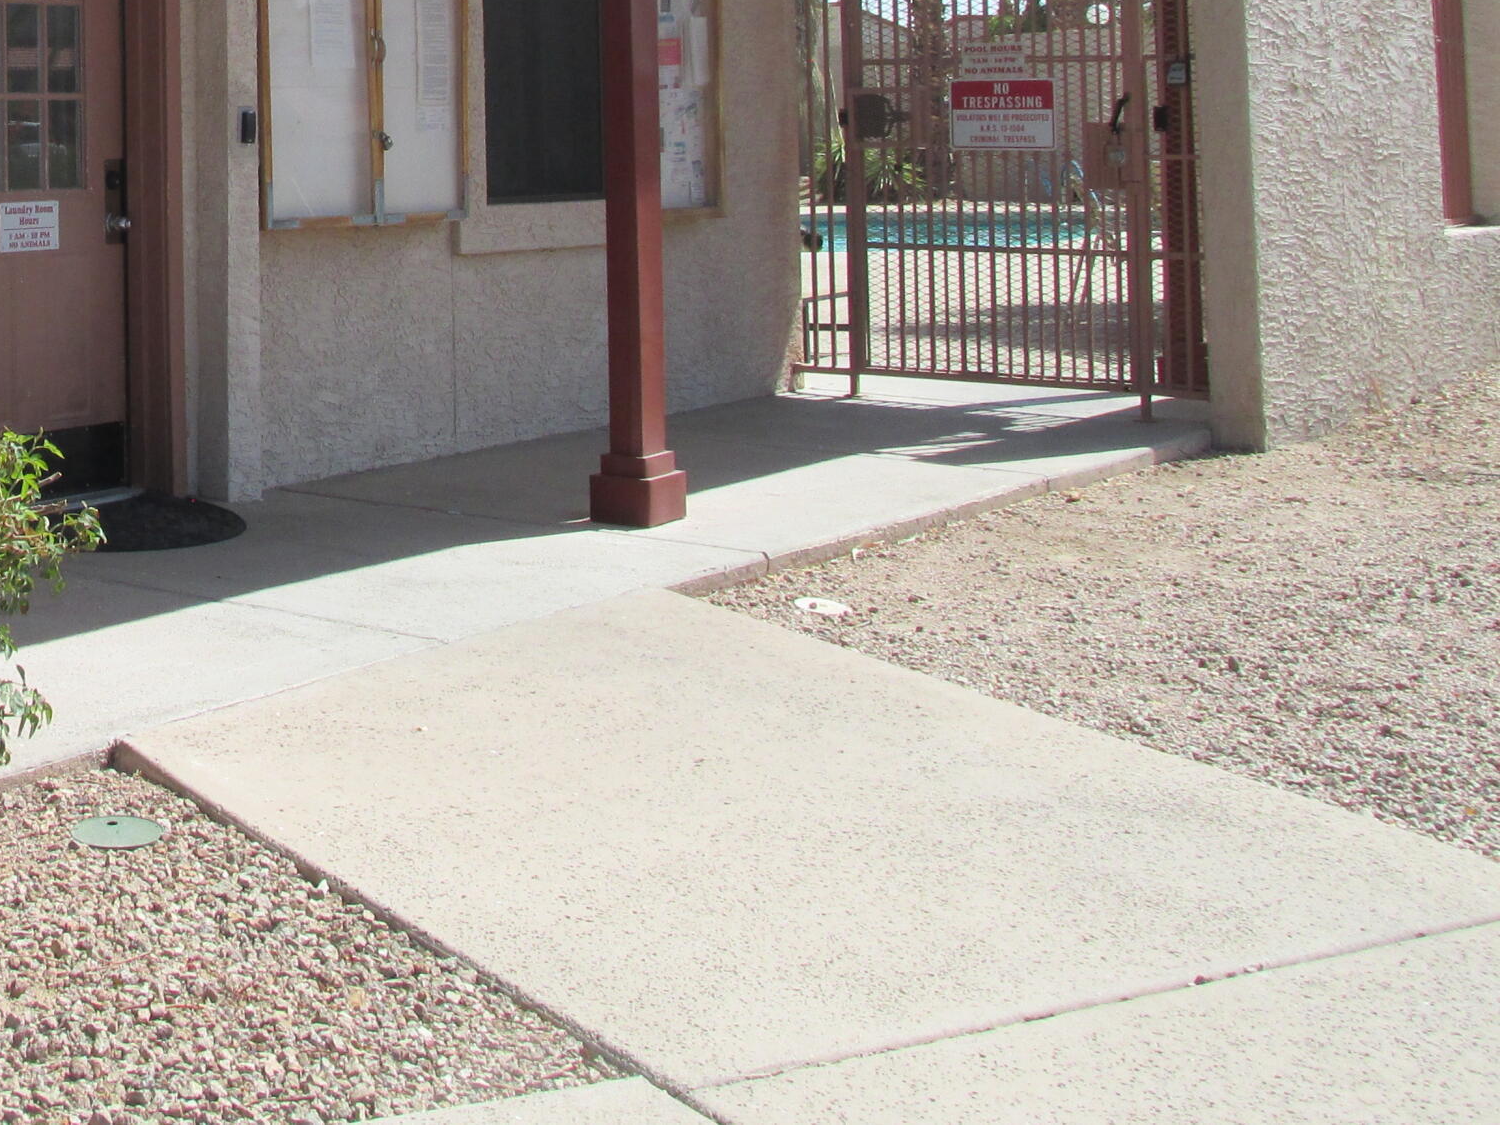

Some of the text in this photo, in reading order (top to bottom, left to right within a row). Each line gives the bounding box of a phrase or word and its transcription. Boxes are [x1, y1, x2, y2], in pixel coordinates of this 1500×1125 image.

[964, 45, 1022, 53] POOL HOURS
[964, 67, 977, 75] NO
[993, 82, 1010, 95] NO
[962, 96, 1043, 109] TRESPASSING
[956, 114, 987, 122] VIOLATORS
[1011, 114, 1050, 122] PROSECUTED
[1003, 135, 1037, 143] TRESPASS
[4, 205, 54, 216] Laundry Room
[19, 217, 40, 226] Hours
[20, 240, 51, 248] ANIMALS
